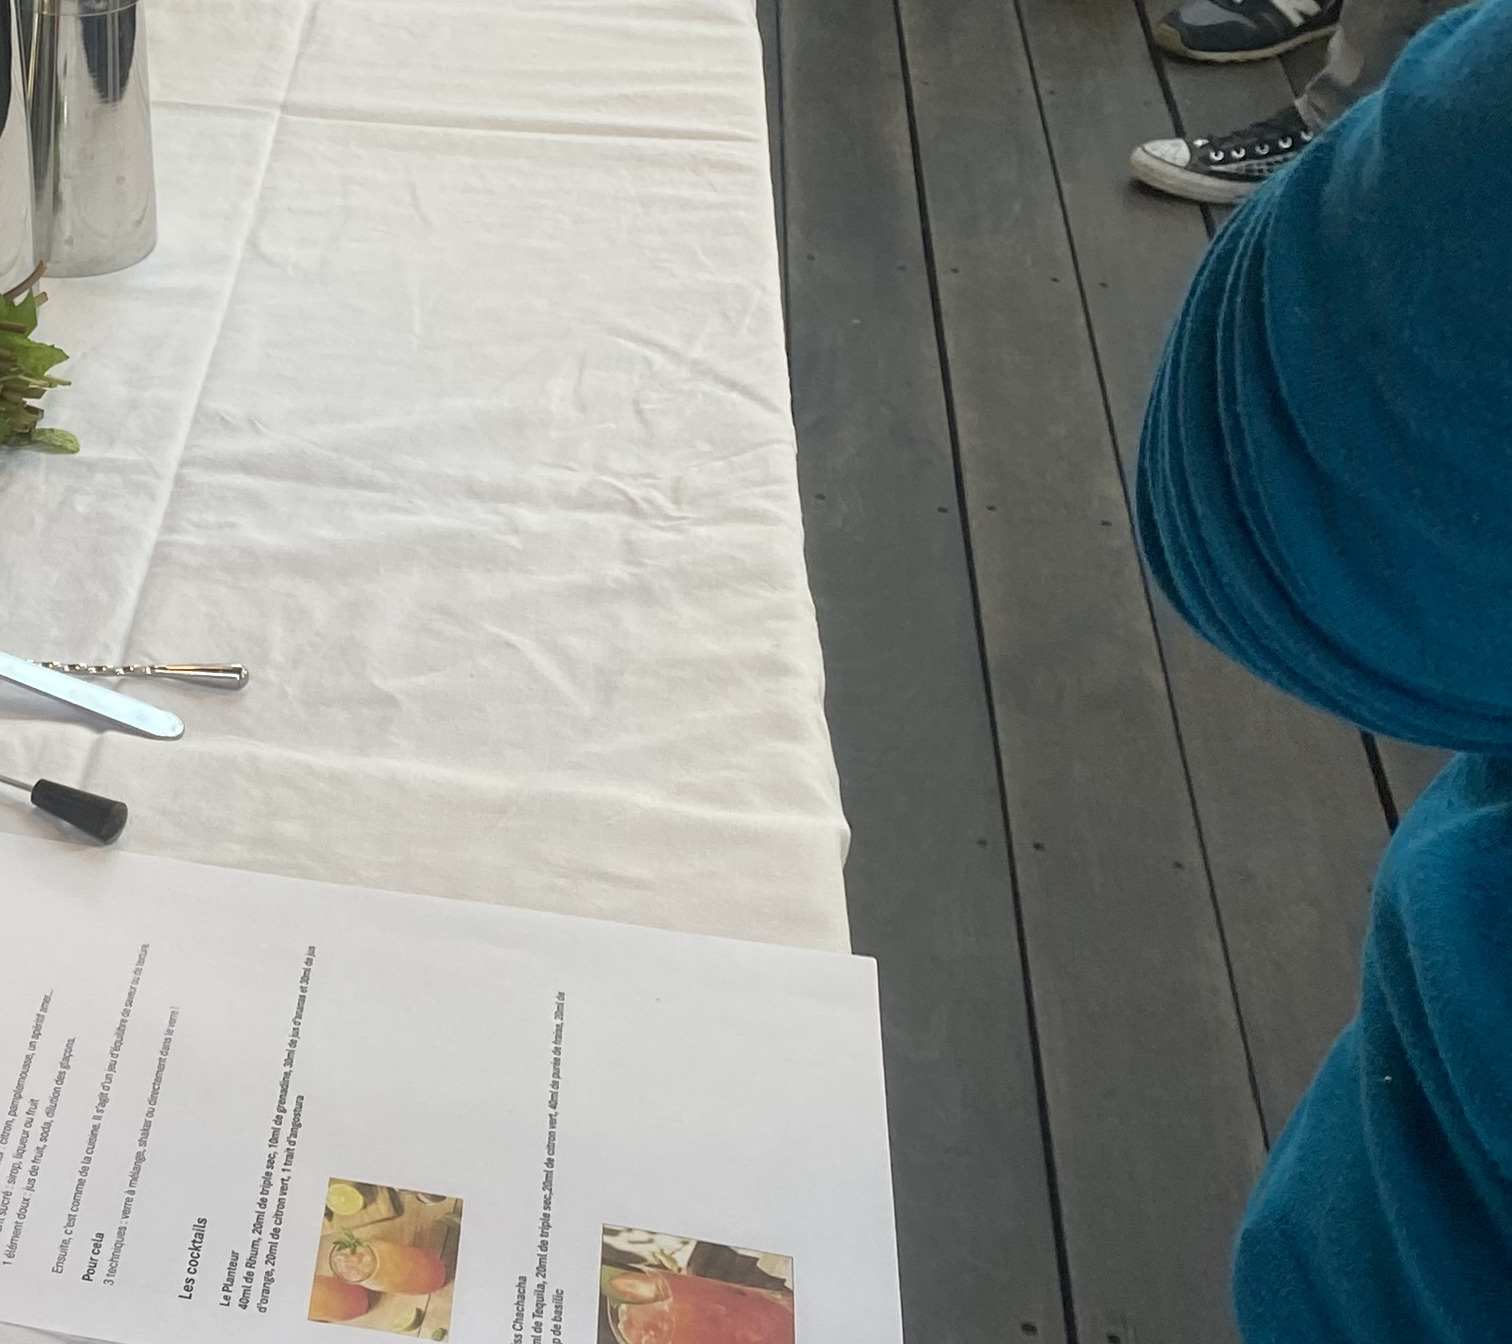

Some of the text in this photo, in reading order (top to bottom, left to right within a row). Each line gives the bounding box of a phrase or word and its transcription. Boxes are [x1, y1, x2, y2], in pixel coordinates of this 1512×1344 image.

[53, 1070, 67, 1086] des
[106, 1059, 118, 1074] jeu
[549, 1079, 560, 1091] de
[24, 1098, 40, 1117] fruit
[44, 1086, 63, 1119] dilution
[547, 1090, 559, 1111] 40ml
[38, 1119, 55, 1144] soda,
[271, 1114, 284, 1127] de
[548, 1111, 559, 1130] vert,
[12, 1128, 30, 1160] liqueur
[85, 1122, 102, 1156] cuisine.
[137, 1118, 153, 1148] shaker
[267, 1126, 282, 1149] 10ml
[546, 1130, 557, 1157] citron
[30, 1144, 48, 1165] fruit,
[80, 1155, 93, 1165] la
[265, 1150, 279, 1171] sec,
[282, 1147, 296, 1167] trait
[543, 1156, 555, 1169] de
[5, 1160, 24, 1186] sirop,
[27, 1164, 40, 1177] de
[77, 1165, 90, 1178] de
[128, 1148, 147, 1189] mélange,
[22, 1177, 37, 1193] jus
[69, 1177, 87, 1213] comme
[259, 1170, 274, 1196] triple
[278, 1175, 292, 1197] vert,
[15, 1196, 32, 1220] doux
[120, 1196, 134, 1220] verre
[256, 1196, 269, 1210] de
[271, 1197, 287, 1226] citron
[251, 1210, 266, 1236] 20ml
[268, 1226, 282, 1241] de
[538, 1212, 553, 1239] triple
[3, 1220, 24, 1259] élément
[105, 1225, 128, 1278] techniques
[536, 1239, 549, 1253] de
[51, 1237, 74, 1275] Ensuite,
[81, 1232, 105, 1282] Pour cela
[178, 1217, 208, 1300] Les cocktails
[244, 1237, 263, 1270] Rhum,
[264, 1241, 279, 1267] 20ml
[219, 1250, 240, 1307] Le Planteur
[242, 1270, 255, 1285] de
[535, 1253, 548, 1280] 20ml
[102, 1278, 115, 1286] 3
[237, 1284, 253, 1311] 40ml
[511, 1275, 528, 1332] Chachacha
[531, 1280, 548, 1319] Tequila,
[550, 1288, 565, 1323] basilic
[530, 1320, 544, 1334] de
[549, 1323, 562, 1337] de
